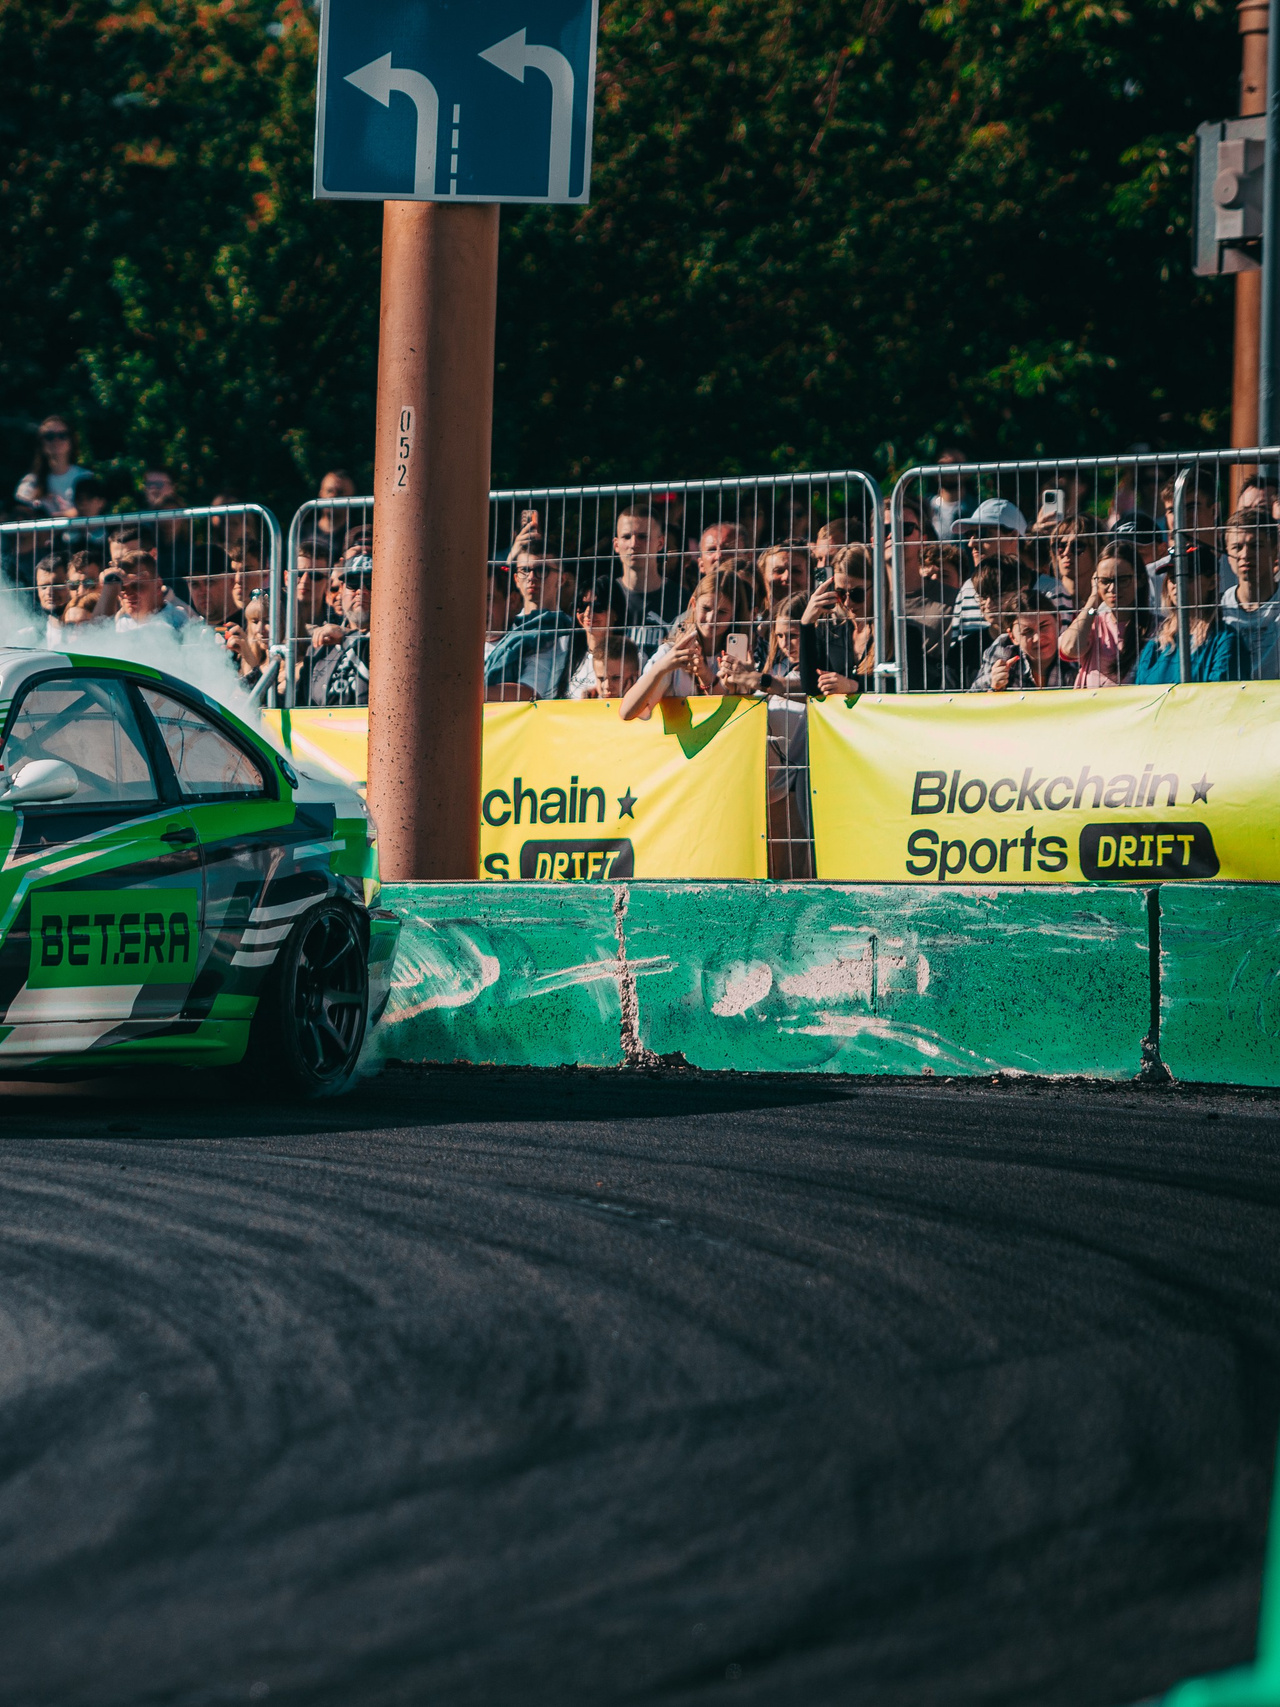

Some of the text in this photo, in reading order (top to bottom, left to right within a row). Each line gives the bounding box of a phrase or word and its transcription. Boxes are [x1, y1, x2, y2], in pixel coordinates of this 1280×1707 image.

[397, 410, 411, 487] 052
[482, 776, 606, 826] chain
[911, 763, 1179, 815] Blockchain
[534, 851, 620, 880] DRIFT
[905, 825, 1195, 880] Sports DRIFT
